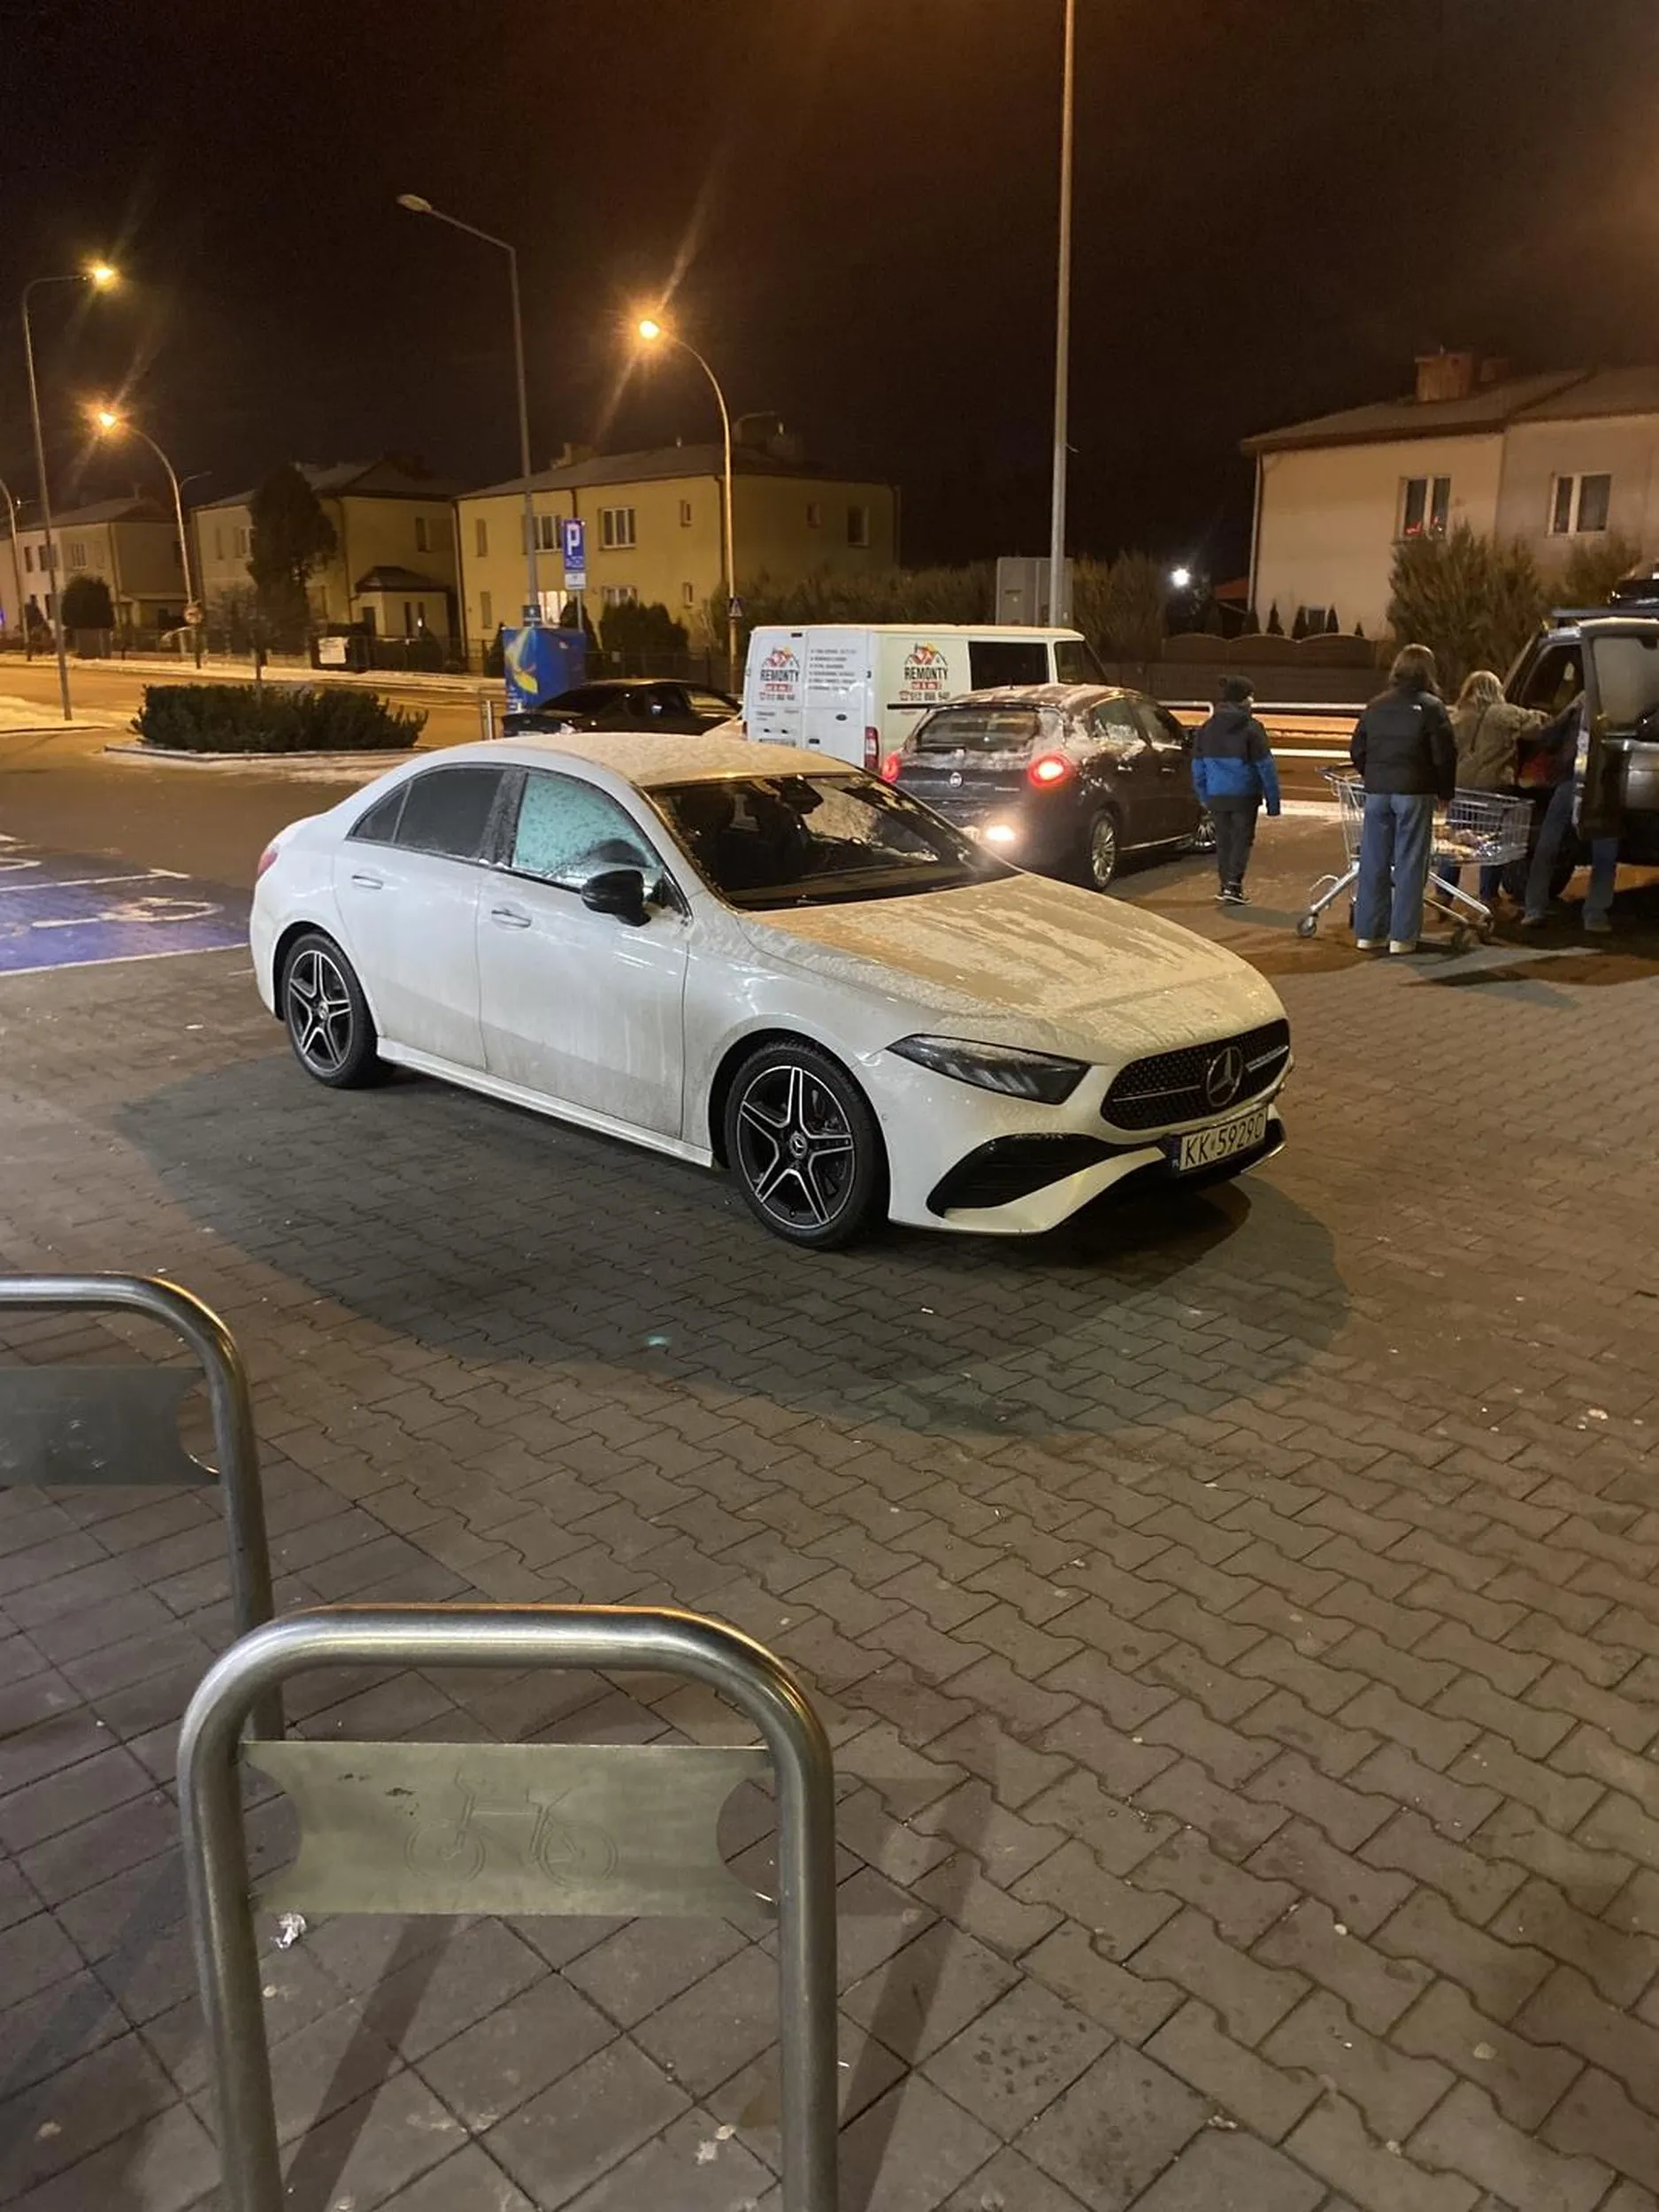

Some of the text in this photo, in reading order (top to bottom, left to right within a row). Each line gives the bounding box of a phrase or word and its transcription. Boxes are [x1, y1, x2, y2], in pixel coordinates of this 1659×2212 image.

[567, 523, 580, 556] P
[760, 669, 799, 682] REMONTY
[904, 667, 948, 680] REMONTY
[1186, 1133, 1210, 1167] KK
